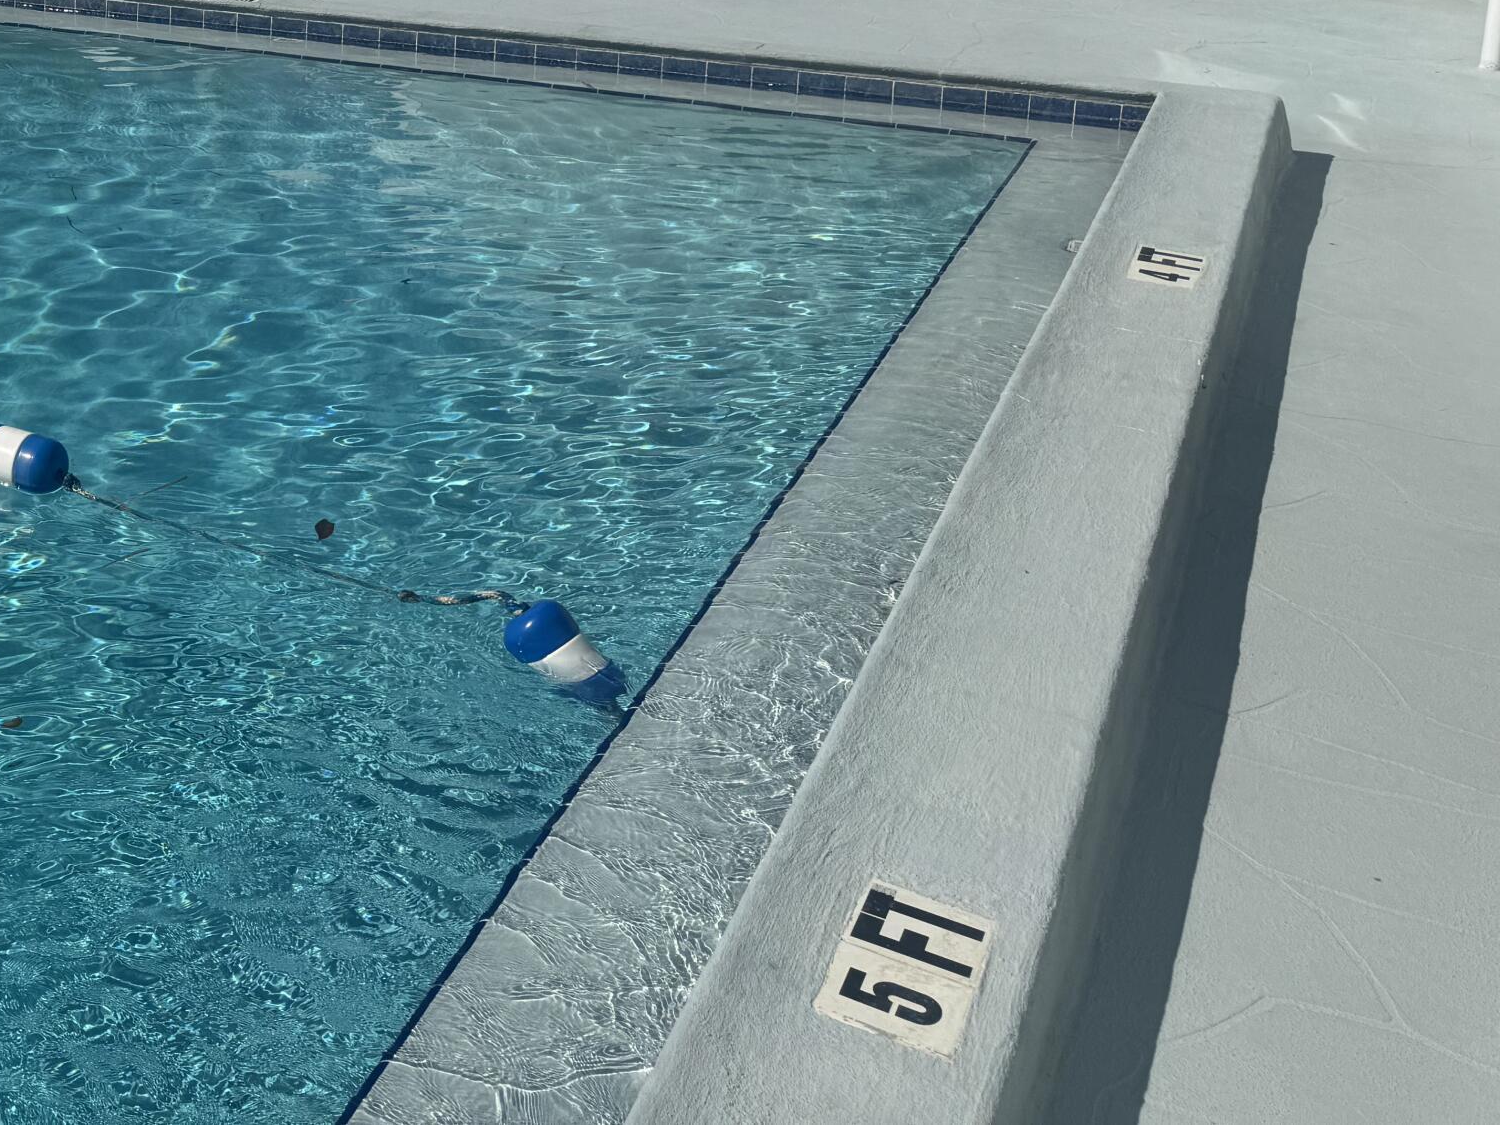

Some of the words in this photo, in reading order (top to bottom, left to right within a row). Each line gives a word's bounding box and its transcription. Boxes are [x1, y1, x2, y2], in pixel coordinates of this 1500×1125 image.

[1137, 246, 1203, 272] FT
[1138, 269, 1190, 282] 4
[850, 888, 986, 979] FT
[838, 966, 943, 1026] 5
